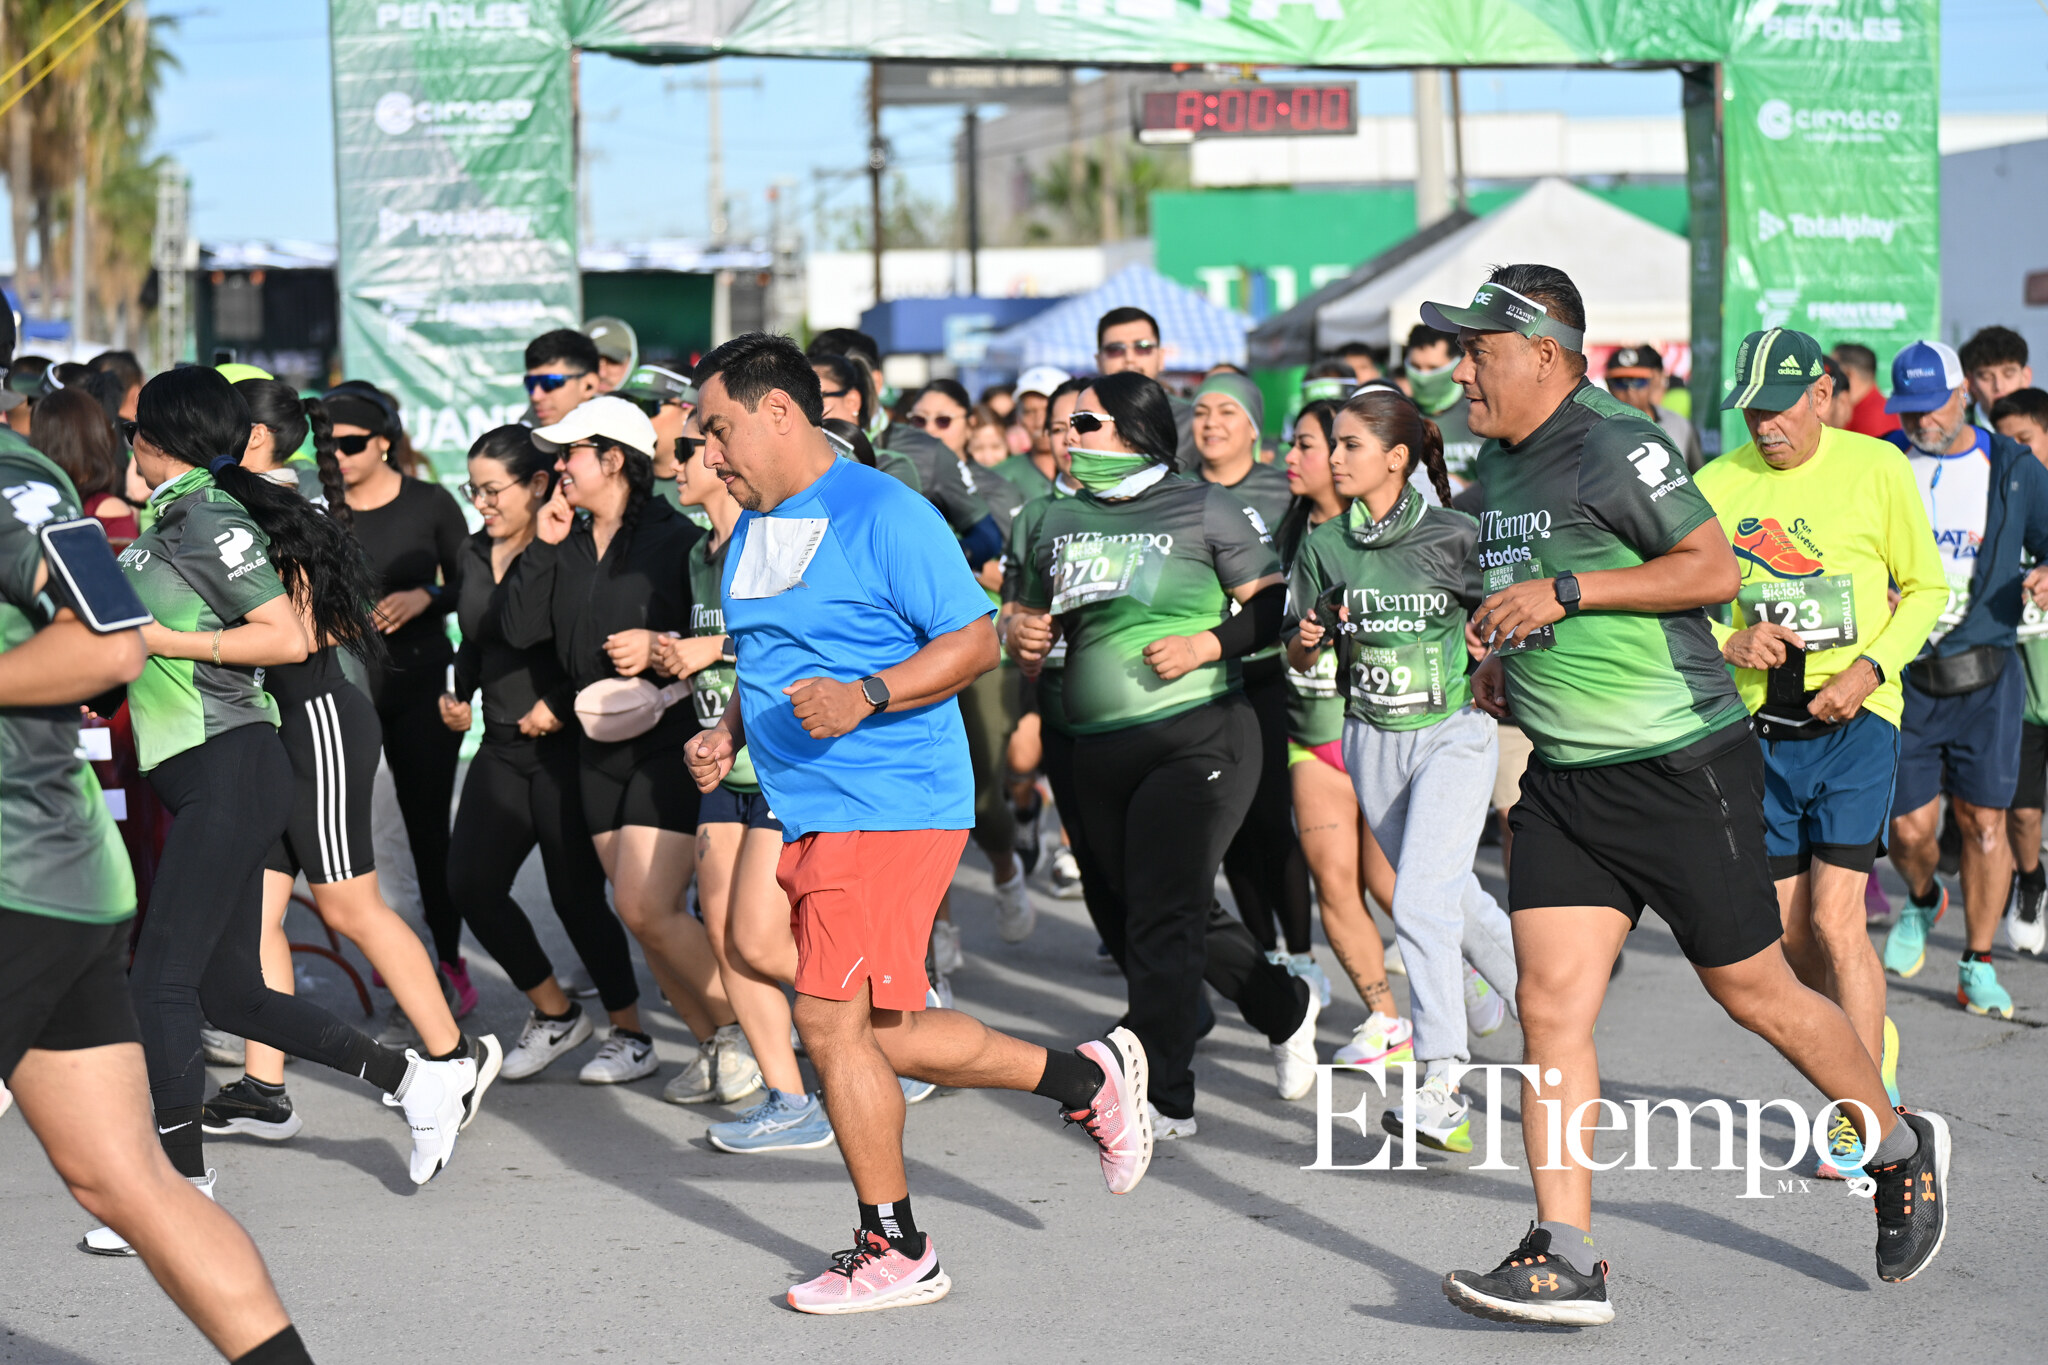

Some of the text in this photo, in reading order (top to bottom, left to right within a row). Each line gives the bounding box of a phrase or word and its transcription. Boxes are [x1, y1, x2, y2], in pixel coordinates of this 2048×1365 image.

[1795, 109, 1900, 130] cimaco
[1787, 213, 1895, 245] Totalplay
[1777, 367, 1803, 376] adidas
[1485, 509, 1552, 543] Tiempo
[1485, 544, 1532, 568] todos
[1489, 565, 1514, 577] CARRERA
[1837, 579, 1851, 588] 123
[1762, 580, 1805, 590] CARRERA
[1353, 588, 1448, 618] Tiempo
[1754, 599, 1823, 630] 123
[1841, 591, 1854, 640] MEDALLA
[1360, 616, 1427, 632] todos
[1356, 662, 1412, 695] 299
[1429, 658, 1442, 705] MEDALLA
